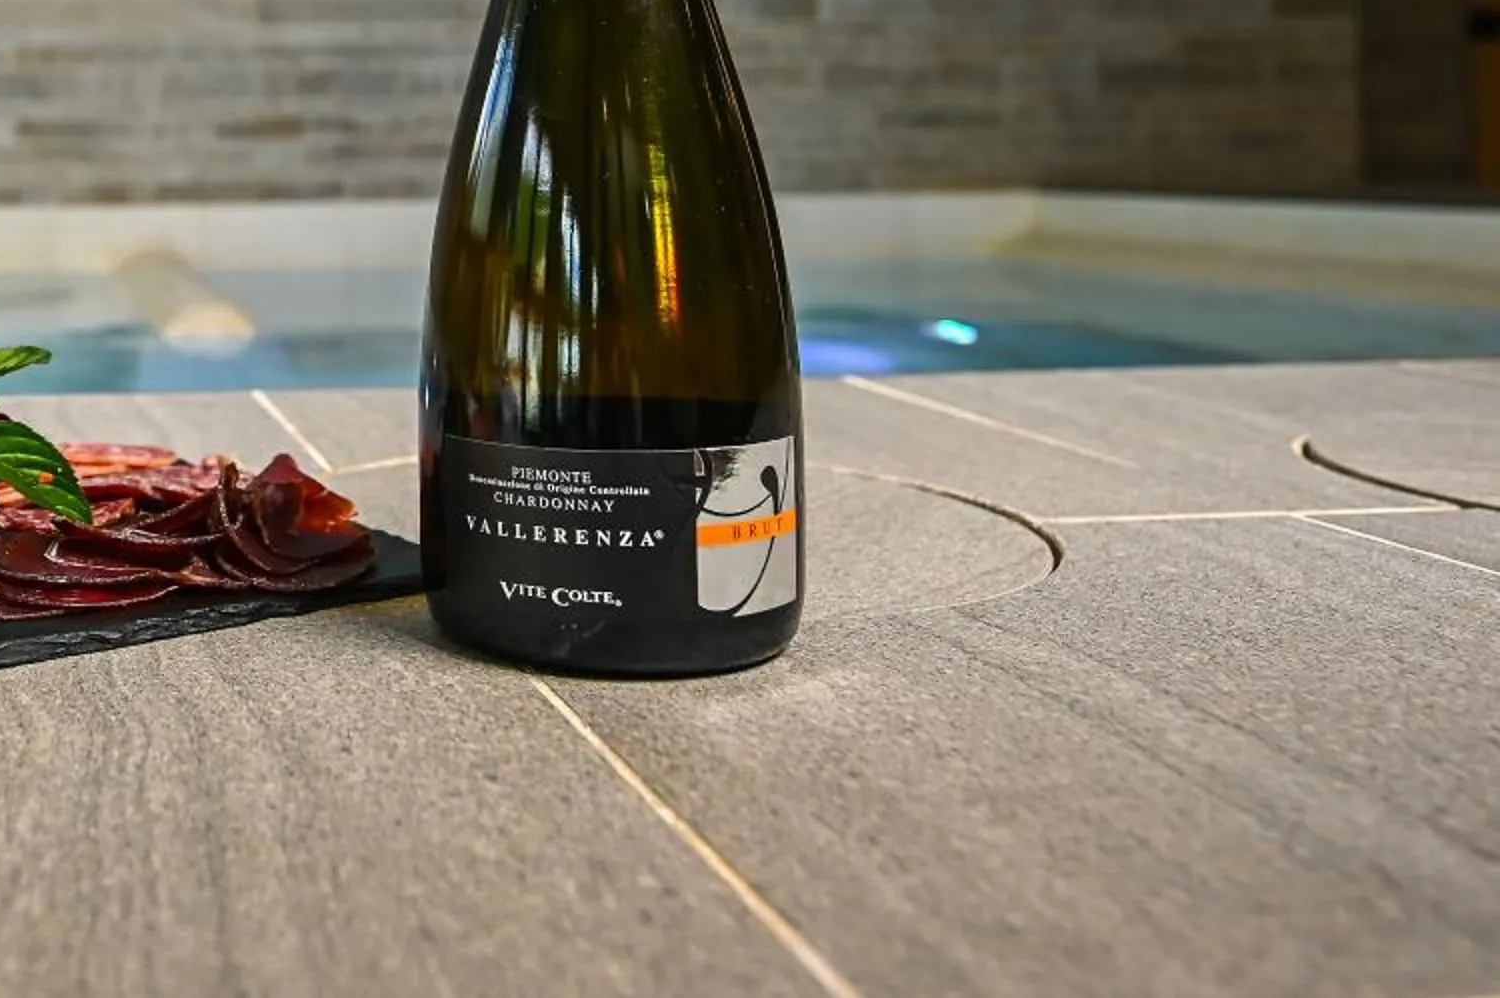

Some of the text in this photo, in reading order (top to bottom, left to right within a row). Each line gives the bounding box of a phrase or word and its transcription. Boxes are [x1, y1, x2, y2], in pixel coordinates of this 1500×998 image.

[511, 465, 593, 485] PIEMONTE
[547, 483, 586, 496] Origine
[589, 485, 651, 497] Controllata
[493, 490, 616, 514] CHARDONNAY
[731, 517, 784, 540] BRUT
